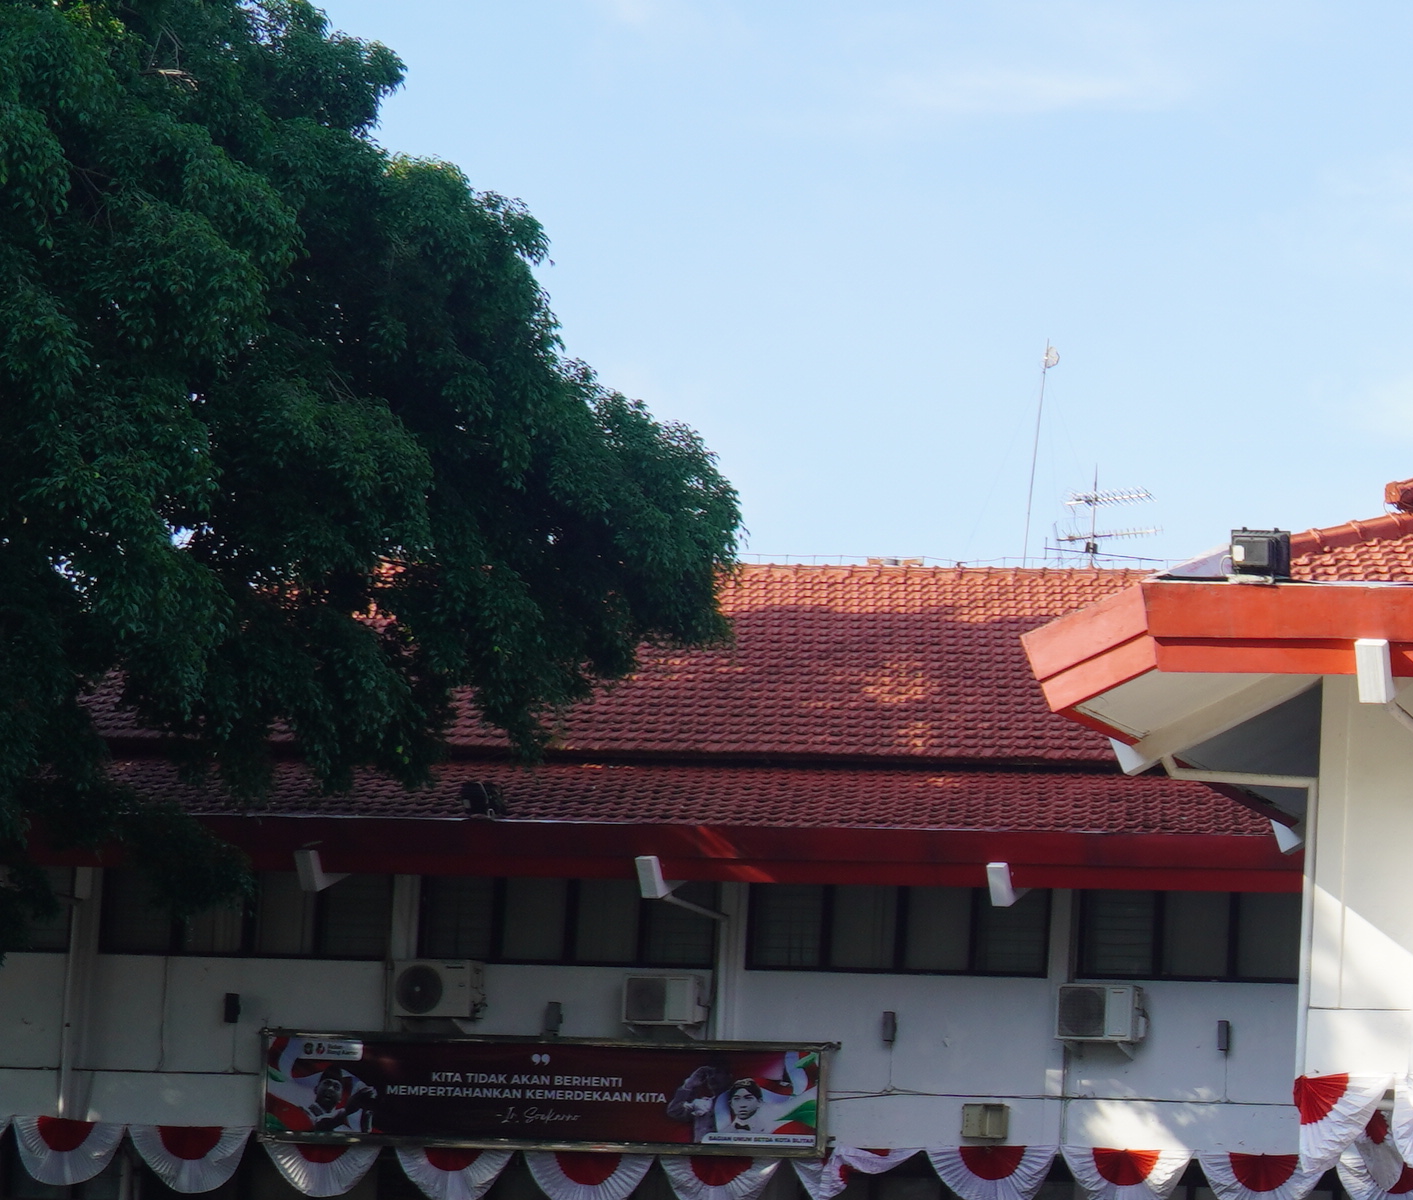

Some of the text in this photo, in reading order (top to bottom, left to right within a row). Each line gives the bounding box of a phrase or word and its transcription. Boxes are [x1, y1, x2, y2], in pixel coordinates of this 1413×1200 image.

[432, 1071, 623, 1088] KITA TIDAK AKAN BERHENTI
[386, 1085, 667, 1104] MEMPERTAHANKAN KEMERDEKAAN KITA
